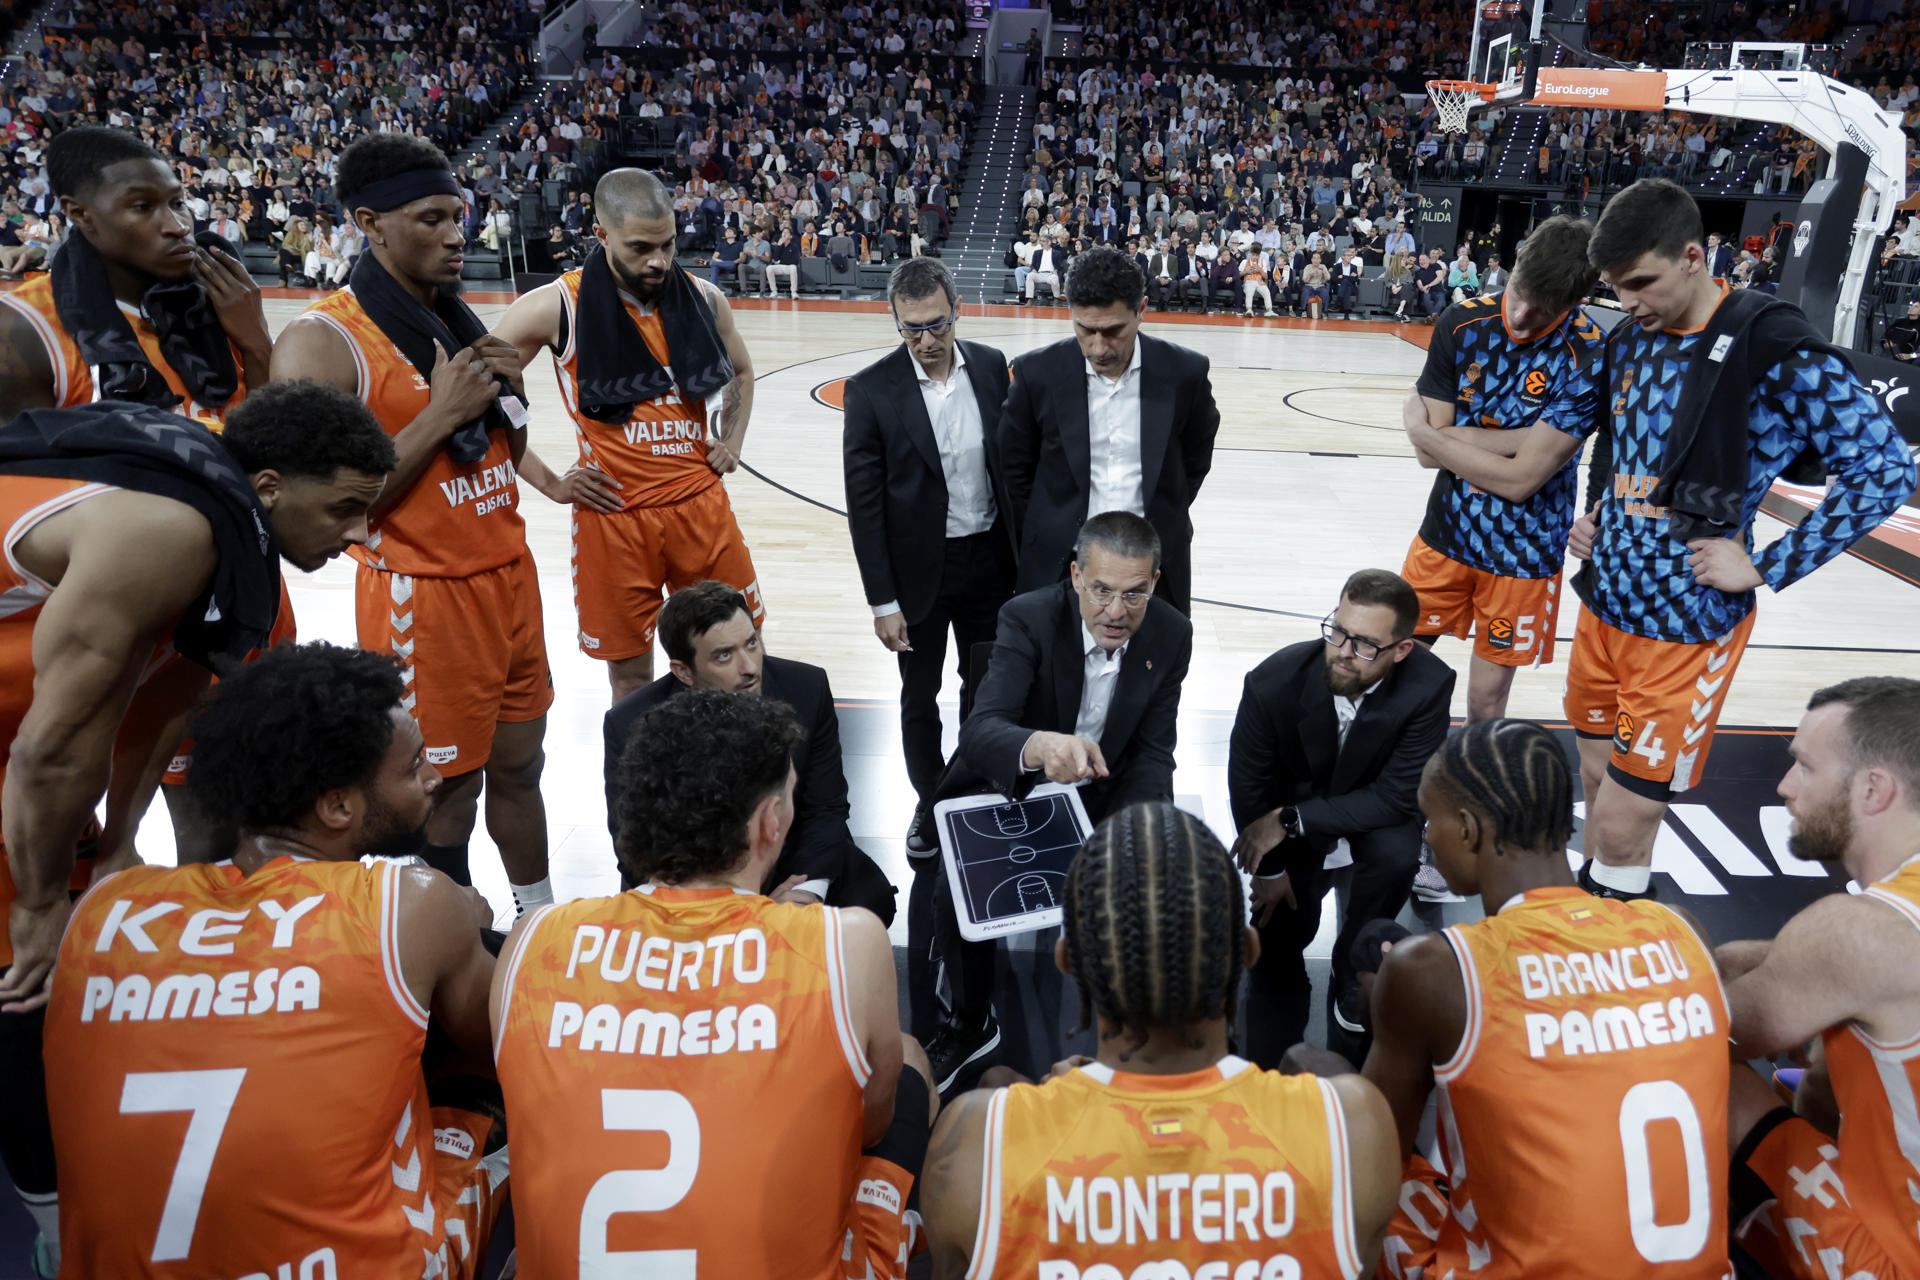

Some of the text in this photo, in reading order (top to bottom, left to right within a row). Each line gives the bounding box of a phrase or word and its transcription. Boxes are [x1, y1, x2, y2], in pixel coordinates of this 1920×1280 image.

[1545, 83, 1610, 98] EuroLeague
[1845, 123, 1878, 158] SPALDING
[651, 441, 694, 456] BASKET
[1513, 615, 1536, 651] 5
[428, 750, 456, 758] PULEVA
[1632, 720, 1667, 768] 4
[94, 893, 326, 956] KEY
[565, 925, 768, 993] PUERTO
[1517, 938, 1690, 1000] BRANCOU
[80, 965, 321, 1023] PAMESA
[548, 1001, 778, 1057] PAMESA
[1524, 993, 1716, 1059] PAMESA
[118, 1067, 248, 1263] 7
[578, 1088, 702, 1280] 2
[1618, 1079, 1712, 1264] 0
[862, 1185, 898, 1208] PULEVA
[1045, 1170, 1297, 1246] MONTERO
